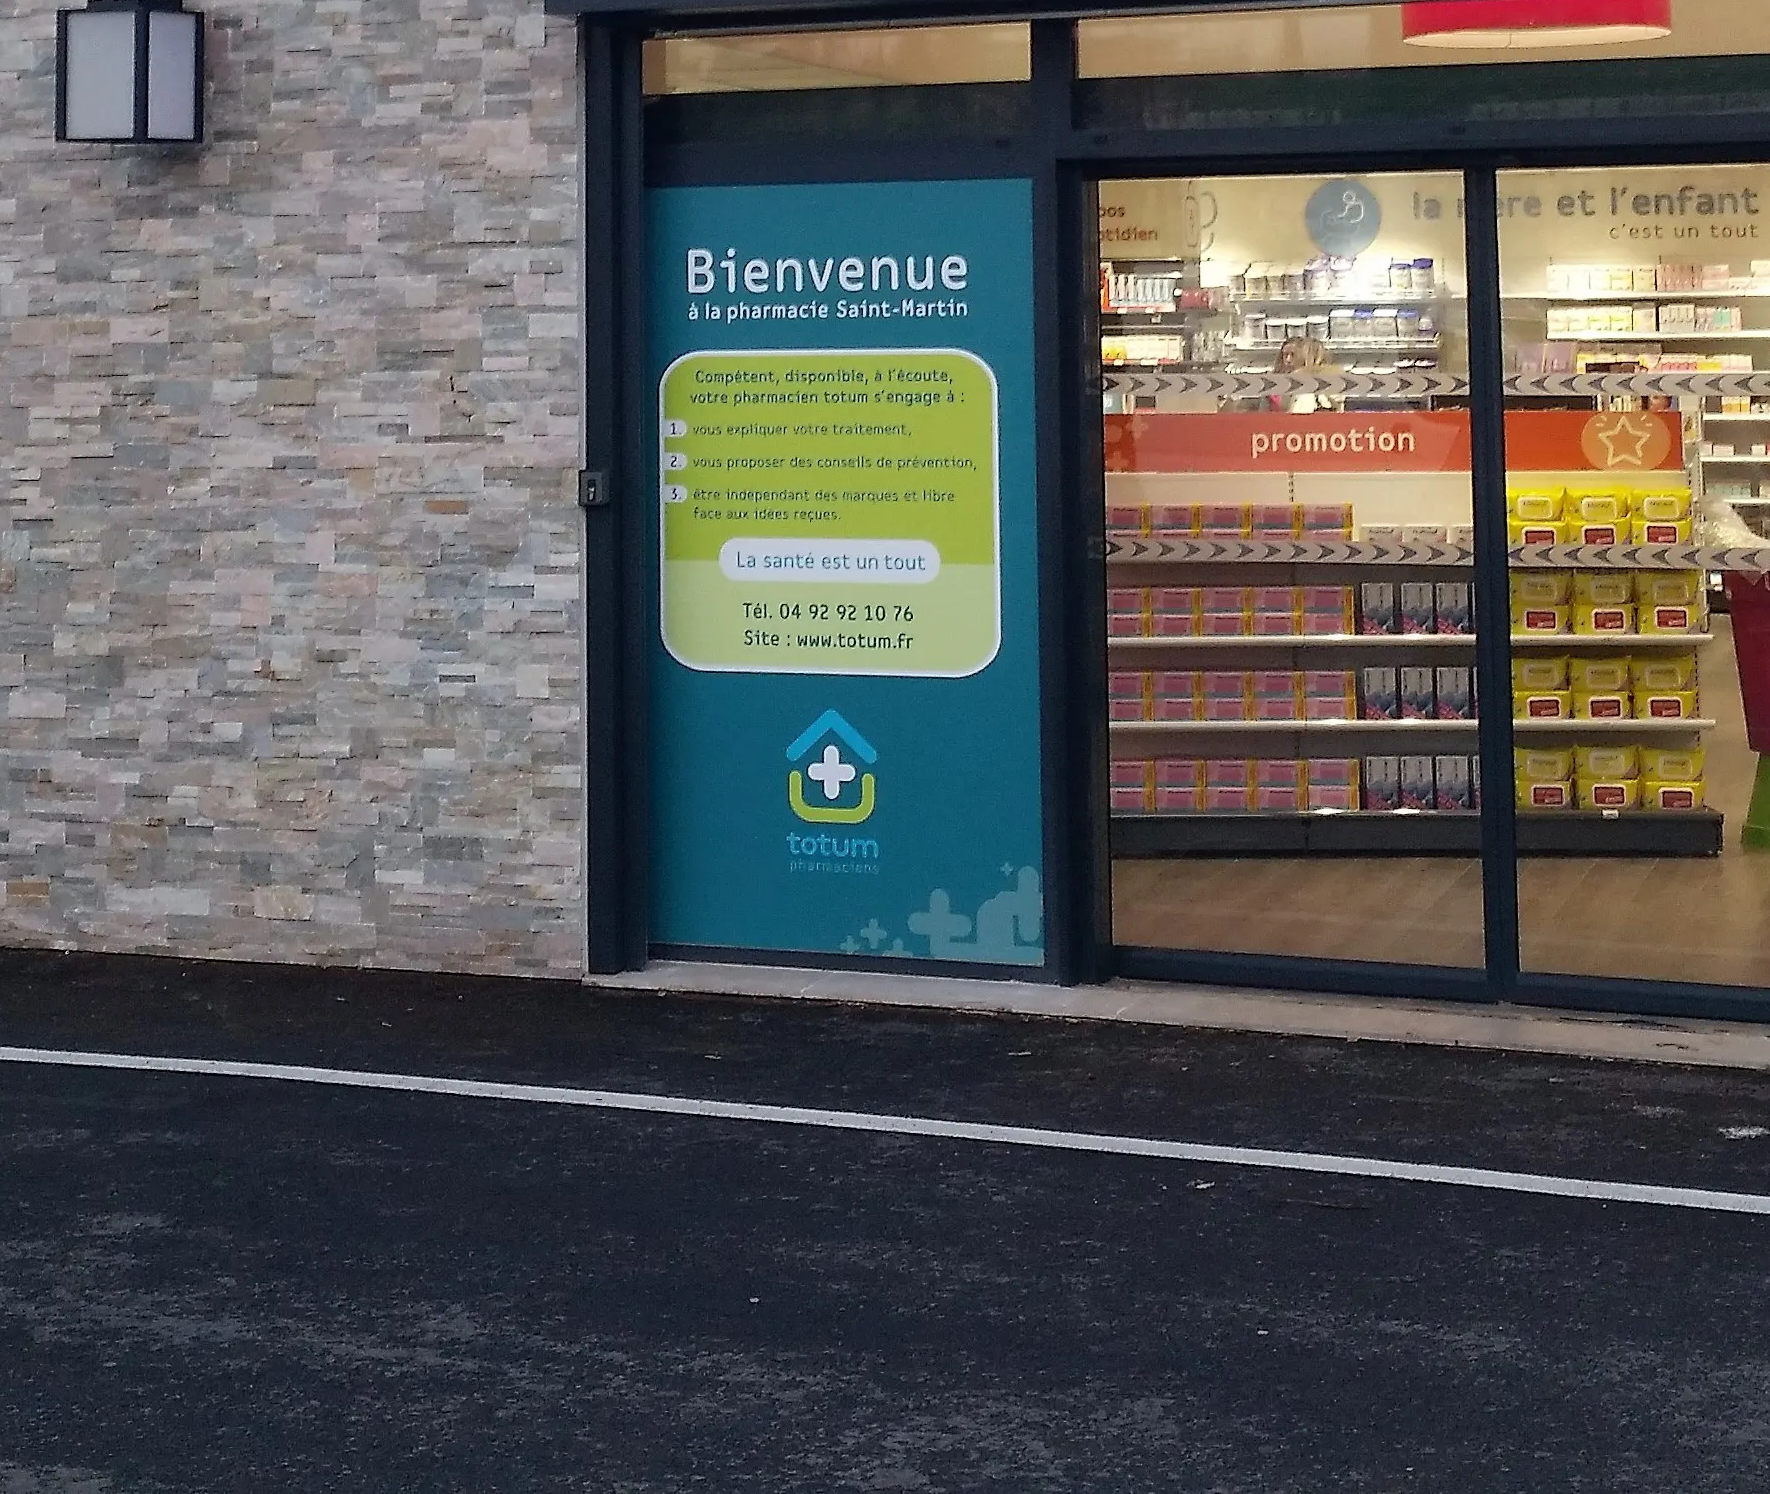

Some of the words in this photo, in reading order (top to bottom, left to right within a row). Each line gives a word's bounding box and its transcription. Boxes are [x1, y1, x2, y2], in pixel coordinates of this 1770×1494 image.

[1557, 190, 1596, 217] et
[1609, 186, 1760, 216] l'enfant
[1609, 223, 1663, 239] c'est
[1674, 227, 1699, 239] un
[1710, 223, 1760, 239] tout
[686, 248, 968, 294] Bienvenue
[688, 302, 698, 320] à
[705, 302, 720, 320] la
[727, 300, 828, 324] pharmacie
[836, 298, 968, 318] Saint-Martin
[695, 370, 780, 386] Compétent,
[785, 369, 869, 385] disponible,
[690, 390, 728, 403] votre
[733, 390, 819, 406] pharmacien
[824, 391, 868, 403] totum
[874, 390, 940, 406] s'engage
[693, 425, 722, 435] vous
[727, 423, 788, 438] expliquer
[793, 425, 828, 435] votre
[832, 423, 912, 437] traitement,
[1251, 427, 1415, 459] promotion
[693, 458, 722, 468] vous
[727, 458, 785, 471] proposer
[790, 457, 812, 468] des
[876, 457, 892, 468] de
[814, 490, 838, 502] des
[842, 491, 898, 504] marques
[904, 491, 918, 502] et
[923, 490, 954, 502] libre
[694, 507, 722, 520] face
[726, 509, 748, 520] aux
[737, 551, 758, 568] La
[764, 552, 814, 569] santé
[821, 554, 850, 570] est
[856, 557, 879, 570] un
[885, 555, 926, 571] tout
[742, 603, 773, 619] Tél.
[779, 604, 801, 619] 04
[809, 604, 829, 620] 92
[837, 605, 857, 620] 92
[865, 605, 886, 621] 10
[893, 606, 914, 622] 76
[744, 630, 780, 646] Site
[797, 632, 914, 649] www.totum.fr
[786, 832, 879, 859] totum
